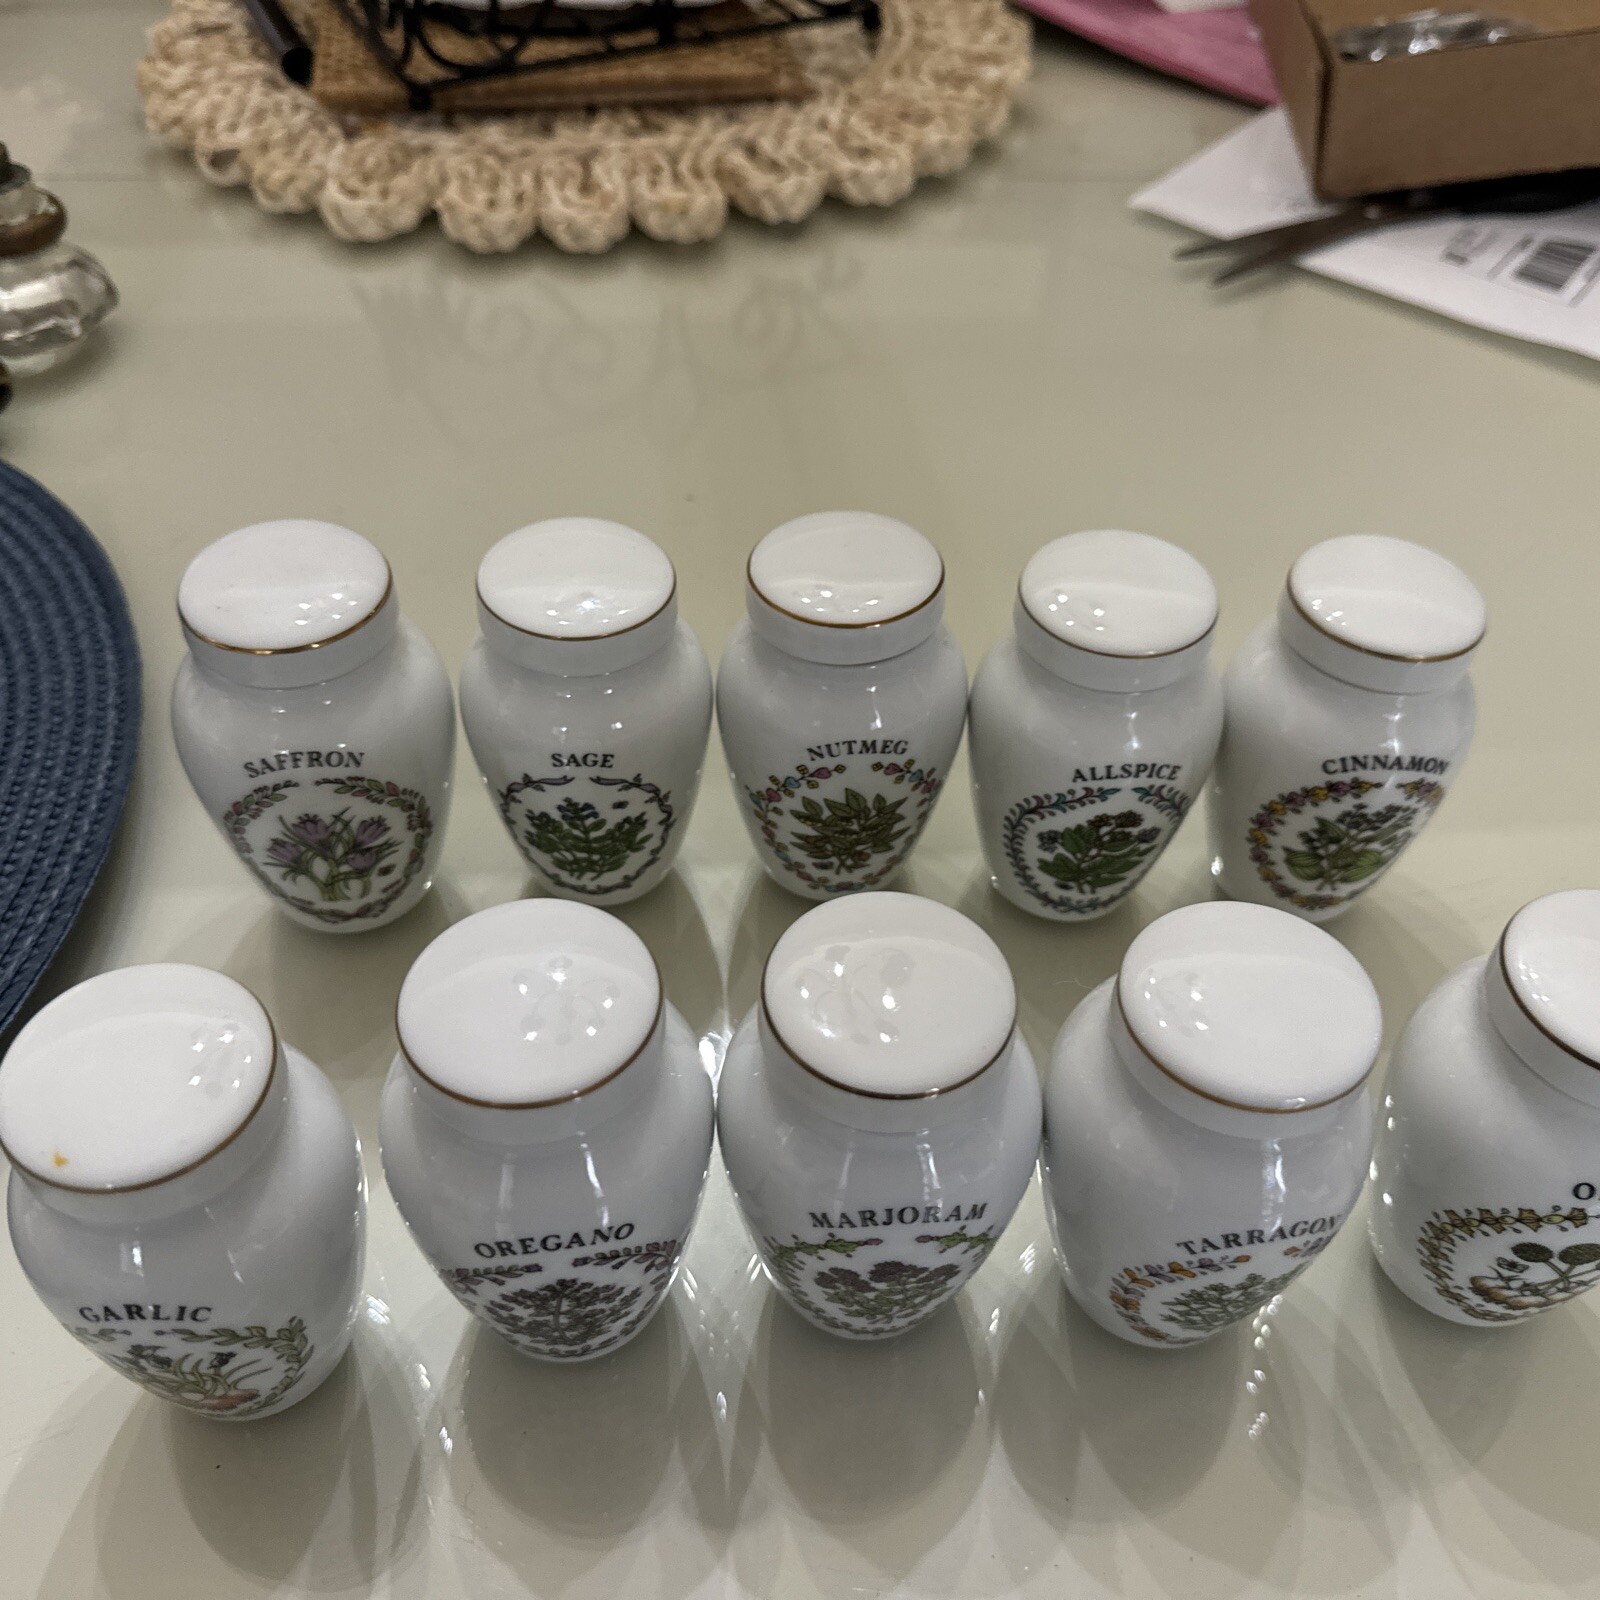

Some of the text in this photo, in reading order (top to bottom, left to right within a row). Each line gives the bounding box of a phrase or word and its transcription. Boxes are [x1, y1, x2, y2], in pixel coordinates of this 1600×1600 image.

[550, 752, 615, 769] SAGE
[806, 739, 909, 762] NUTMEG
[243, 750, 365, 779] SAFFRON
[1071, 763, 1183, 783] ALLSPICE
[1321, 754, 1451, 776] CINNAMON
[808, 1202, 988, 1230] MARJORAM
[473, 1223, 636, 1259] OREGANO
[1175, 1214, 1342, 1257] TARRAGON
[78, 1303, 213, 1323] GARLIC
